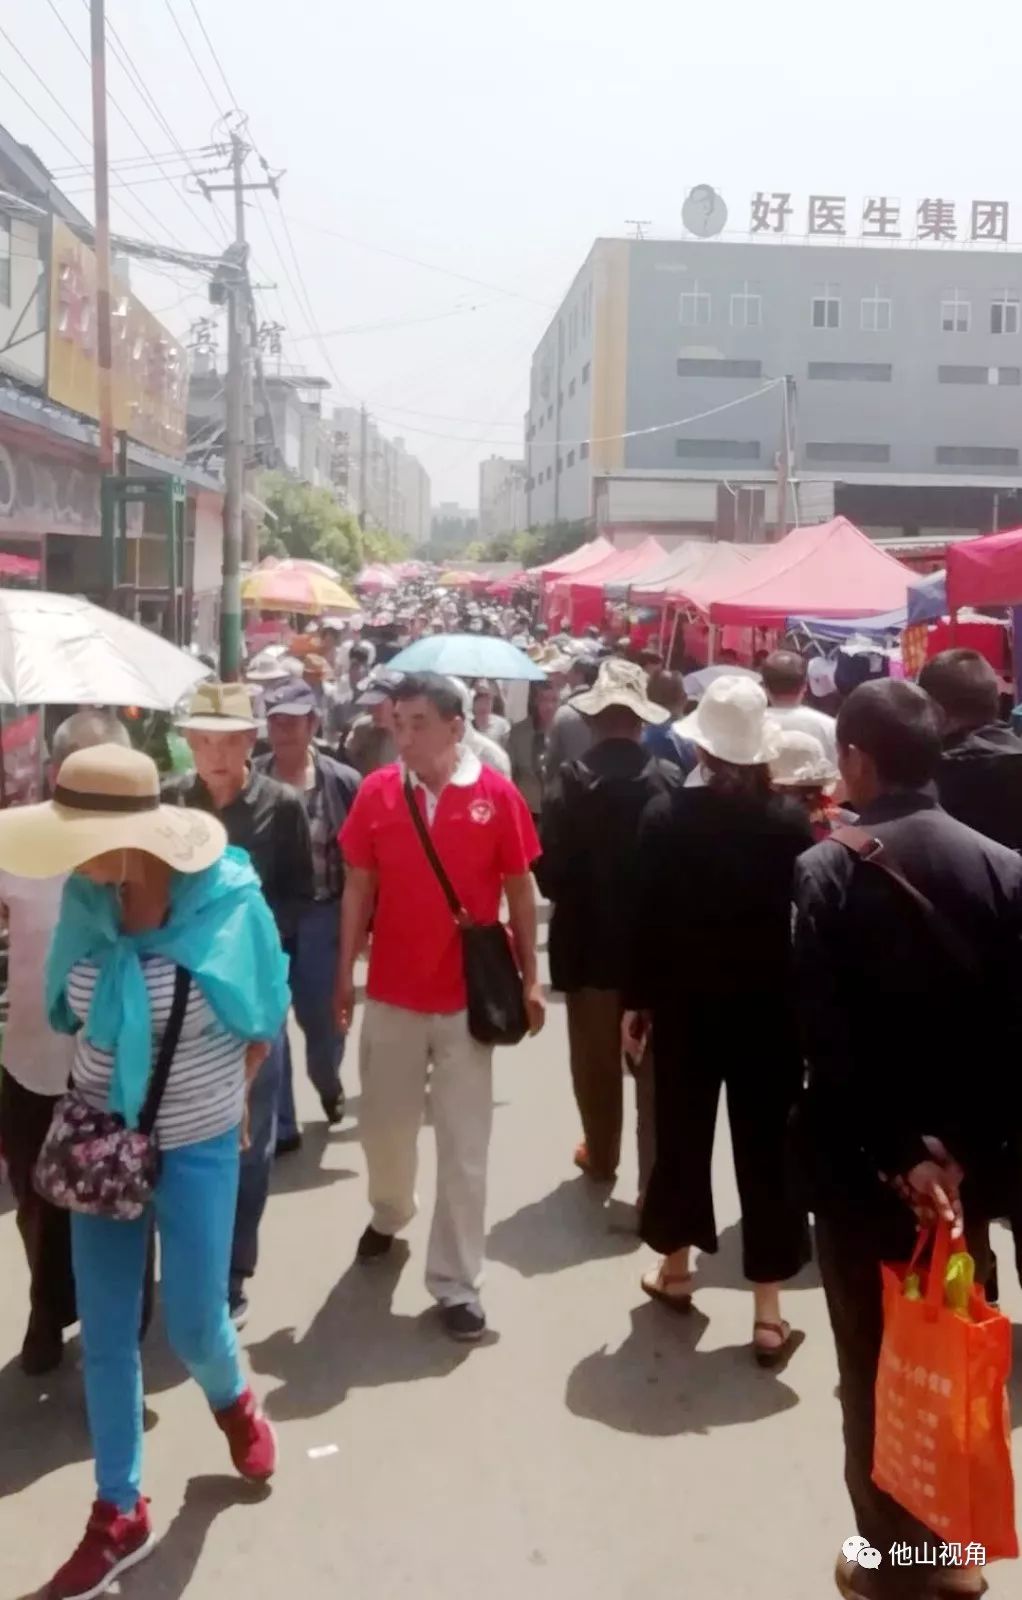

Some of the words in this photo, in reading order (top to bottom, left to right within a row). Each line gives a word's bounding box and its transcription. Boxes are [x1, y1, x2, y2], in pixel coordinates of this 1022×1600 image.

[751, 192, 1009, 242] 好医生集团
